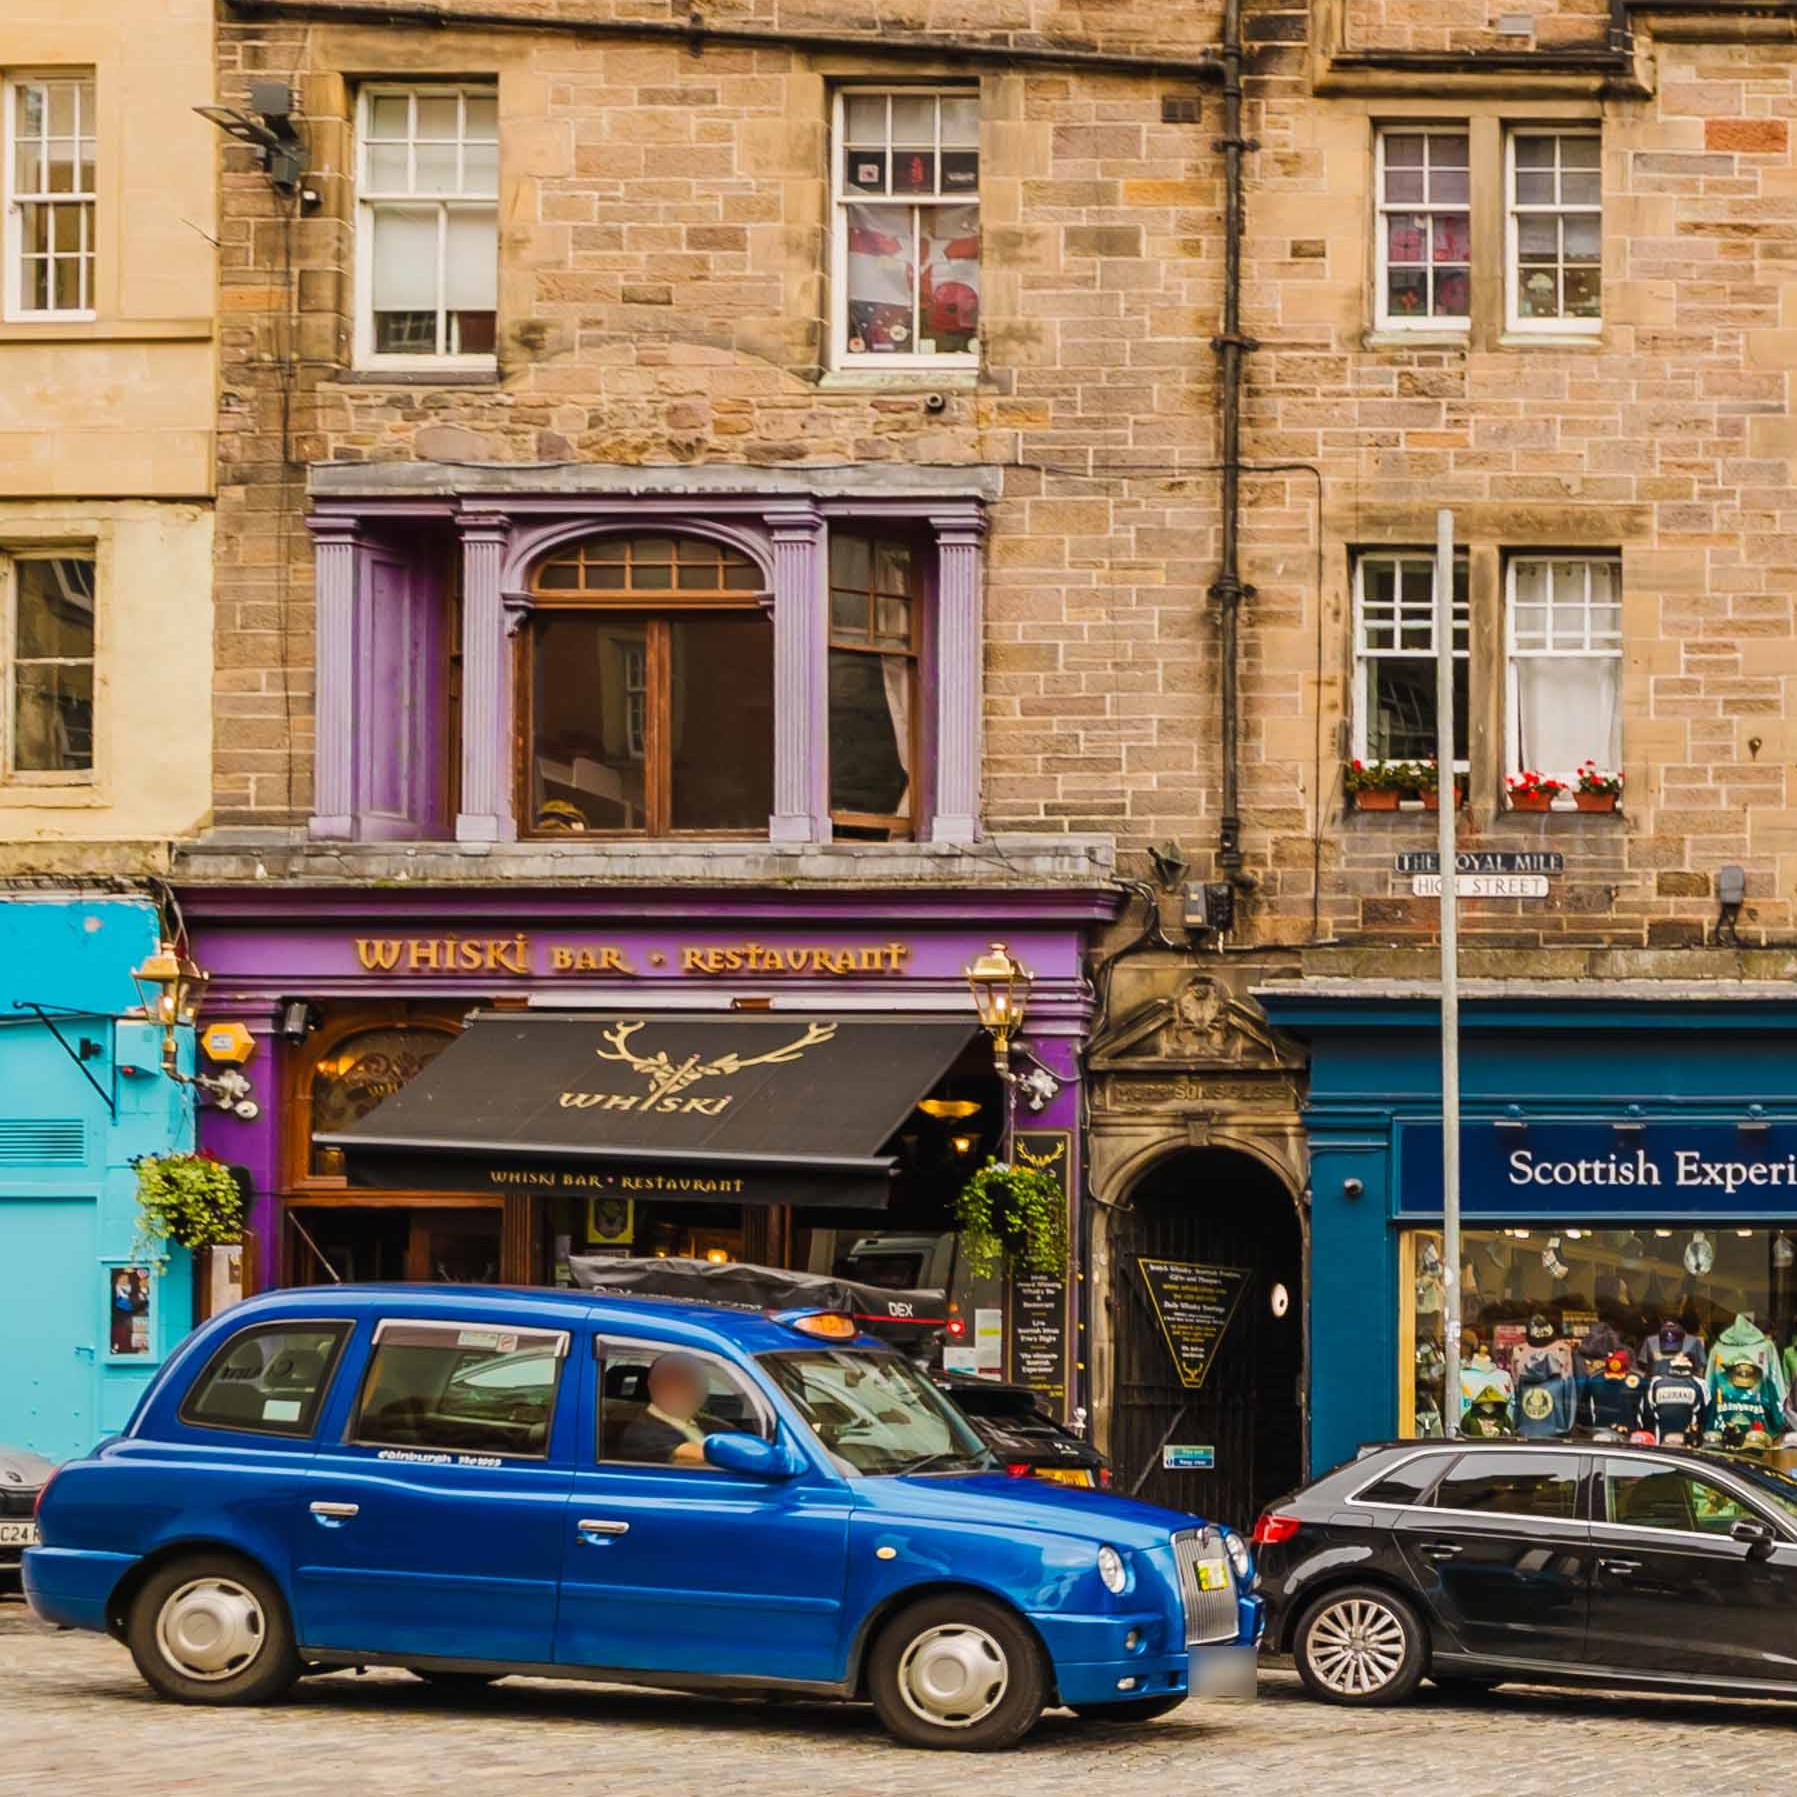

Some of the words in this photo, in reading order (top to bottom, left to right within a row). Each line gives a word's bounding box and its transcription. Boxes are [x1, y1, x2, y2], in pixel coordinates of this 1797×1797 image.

[1402, 854, 1437, 871] THE
[1455, 854, 1507, 871] OYAL
[1514, 854, 1562, 871] MILE
[1472, 879, 1544, 894] STREET
[552, 945, 638, 975] BAR
[683, 943, 910, 974] RESTAURANT
[1508, 1149, 1661, 1185] Scottish
[563, 1172, 602, 1188] BAR
[622, 1175, 744, 1193] RESTAURANT
[888, 1302, 913, 1317] DEX
